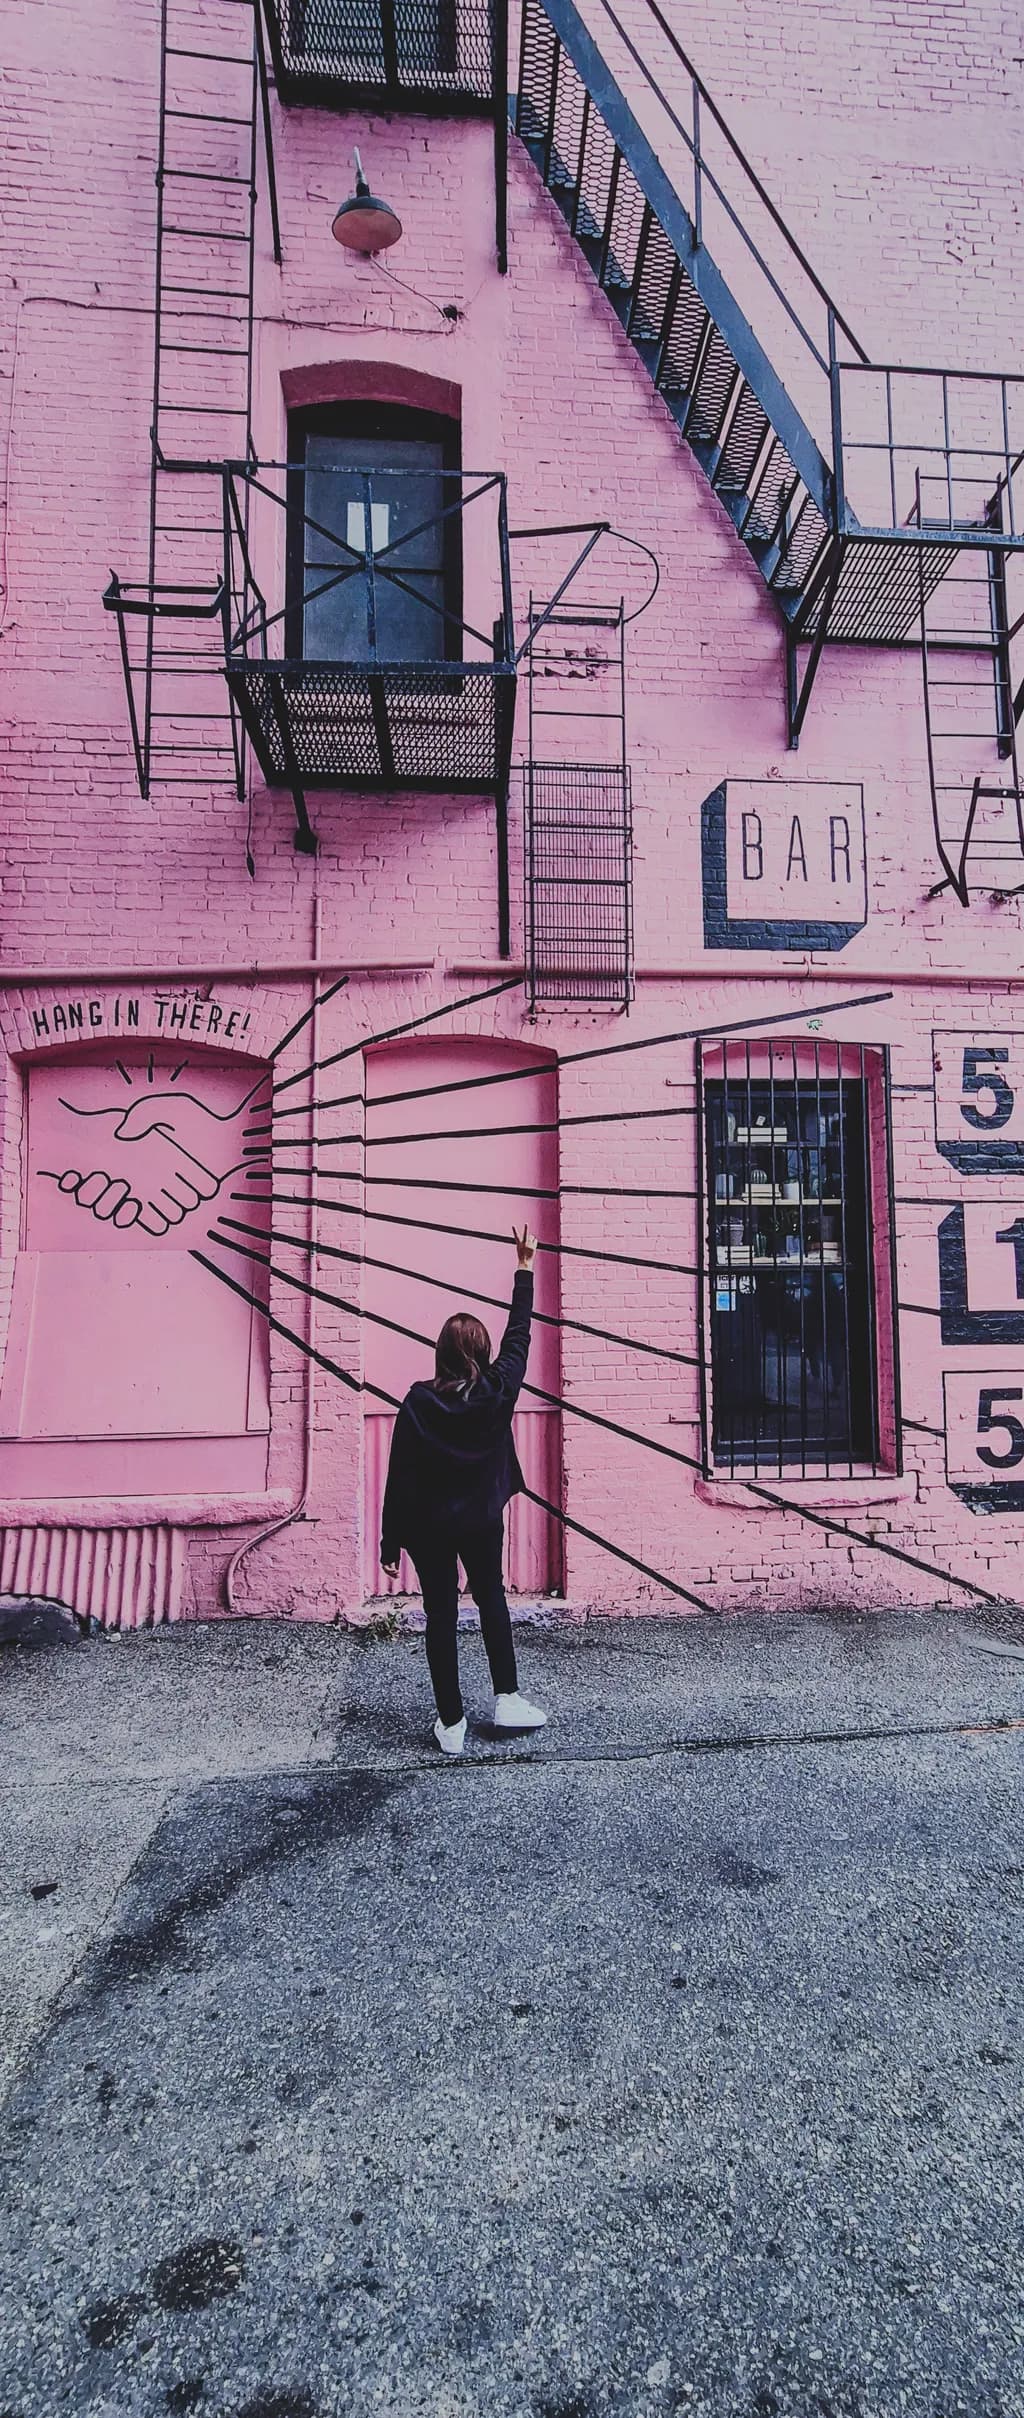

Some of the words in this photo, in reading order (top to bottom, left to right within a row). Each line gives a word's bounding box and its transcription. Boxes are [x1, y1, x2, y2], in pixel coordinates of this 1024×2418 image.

[741, 812, 851, 883] BAR
[32, 1001, 102, 1037] HANG
[114, 999, 140, 1028] IN
[154, 1000, 251, 1040] THERE!
[960, 1047, 1015, 1130] 5
